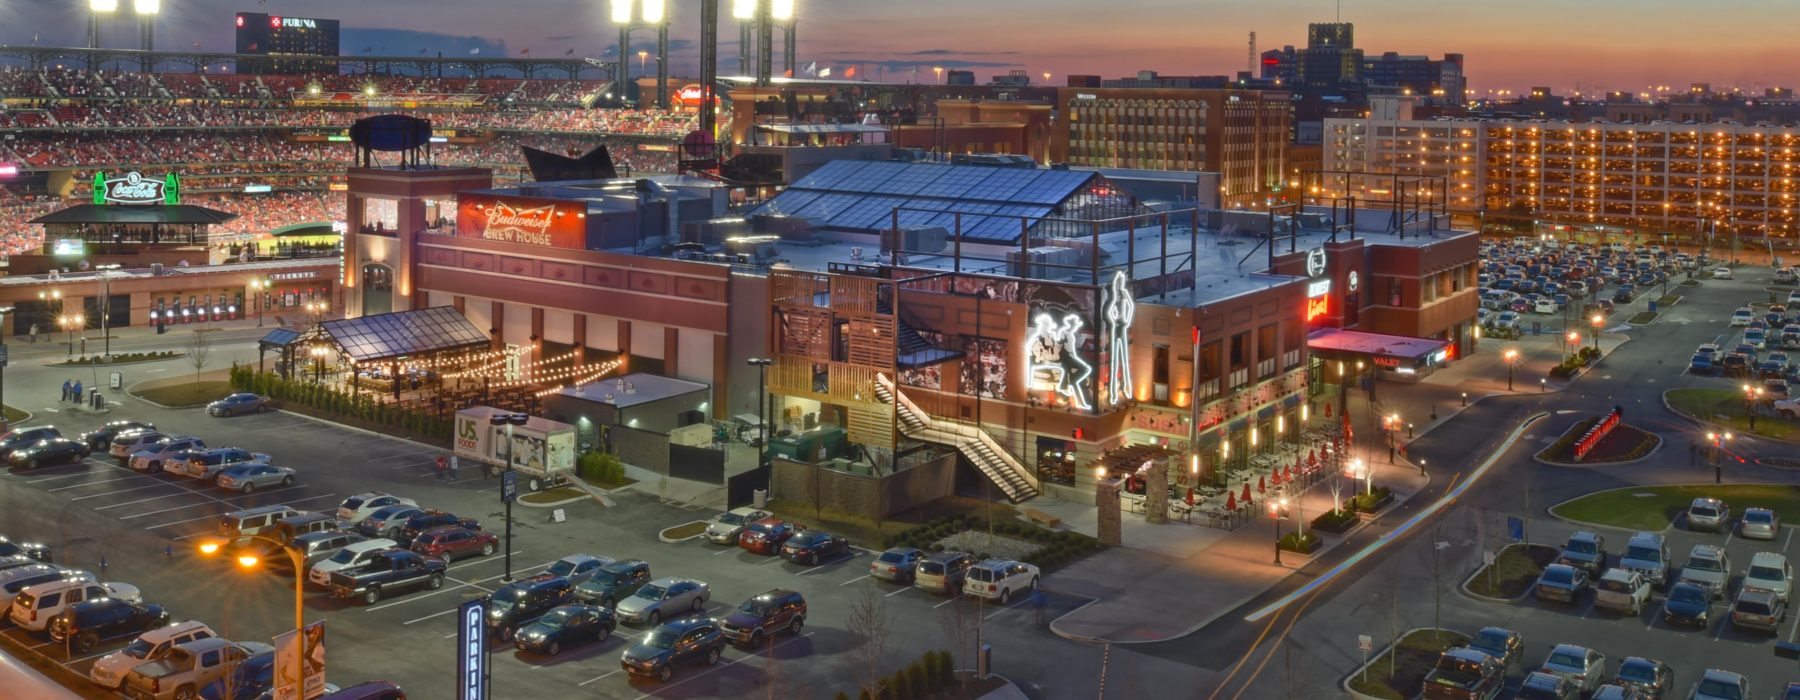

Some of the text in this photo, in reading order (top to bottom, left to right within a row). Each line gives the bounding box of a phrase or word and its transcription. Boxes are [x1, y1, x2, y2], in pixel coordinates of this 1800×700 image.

[282, 17, 316, 29] PURINA
[112, 182, 158, 198] Coca-Cola
[485, 208, 551, 228] Budweiser
[486, 228, 552, 245] BREW HOUSE
[276, 271, 315, 280] TICKETS
[1373, 356, 1401, 367] VALET
[458, 438, 477, 449] FOODS
